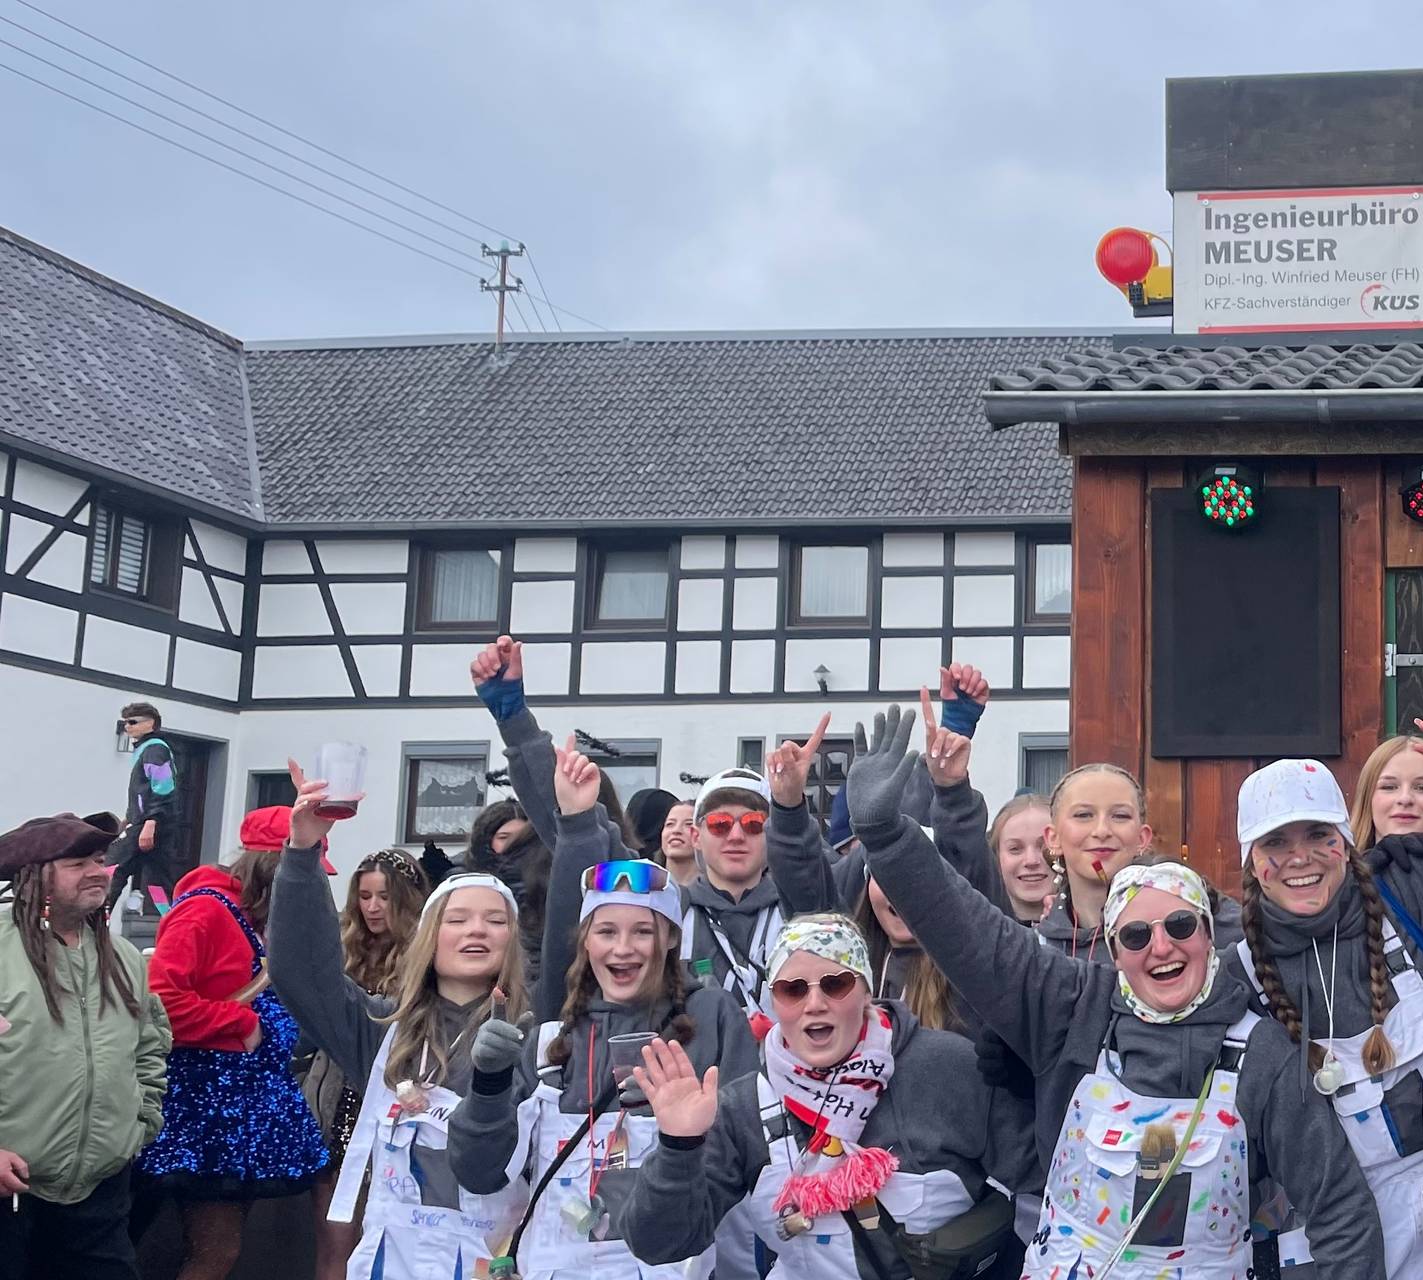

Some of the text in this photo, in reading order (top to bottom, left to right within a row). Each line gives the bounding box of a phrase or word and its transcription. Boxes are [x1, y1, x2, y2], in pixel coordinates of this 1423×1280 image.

[1205, 202, 1419, 234] Ingenieurbüro
[1205, 238, 1338, 264] MEUSER
[1204, 267, 1420, 288] Dipl.-Ing. Winfried Meuser (FH)
[1205, 295, 1351, 310] KFZ-Sachverständiger
[1373, 295, 1419, 311] KÜS
